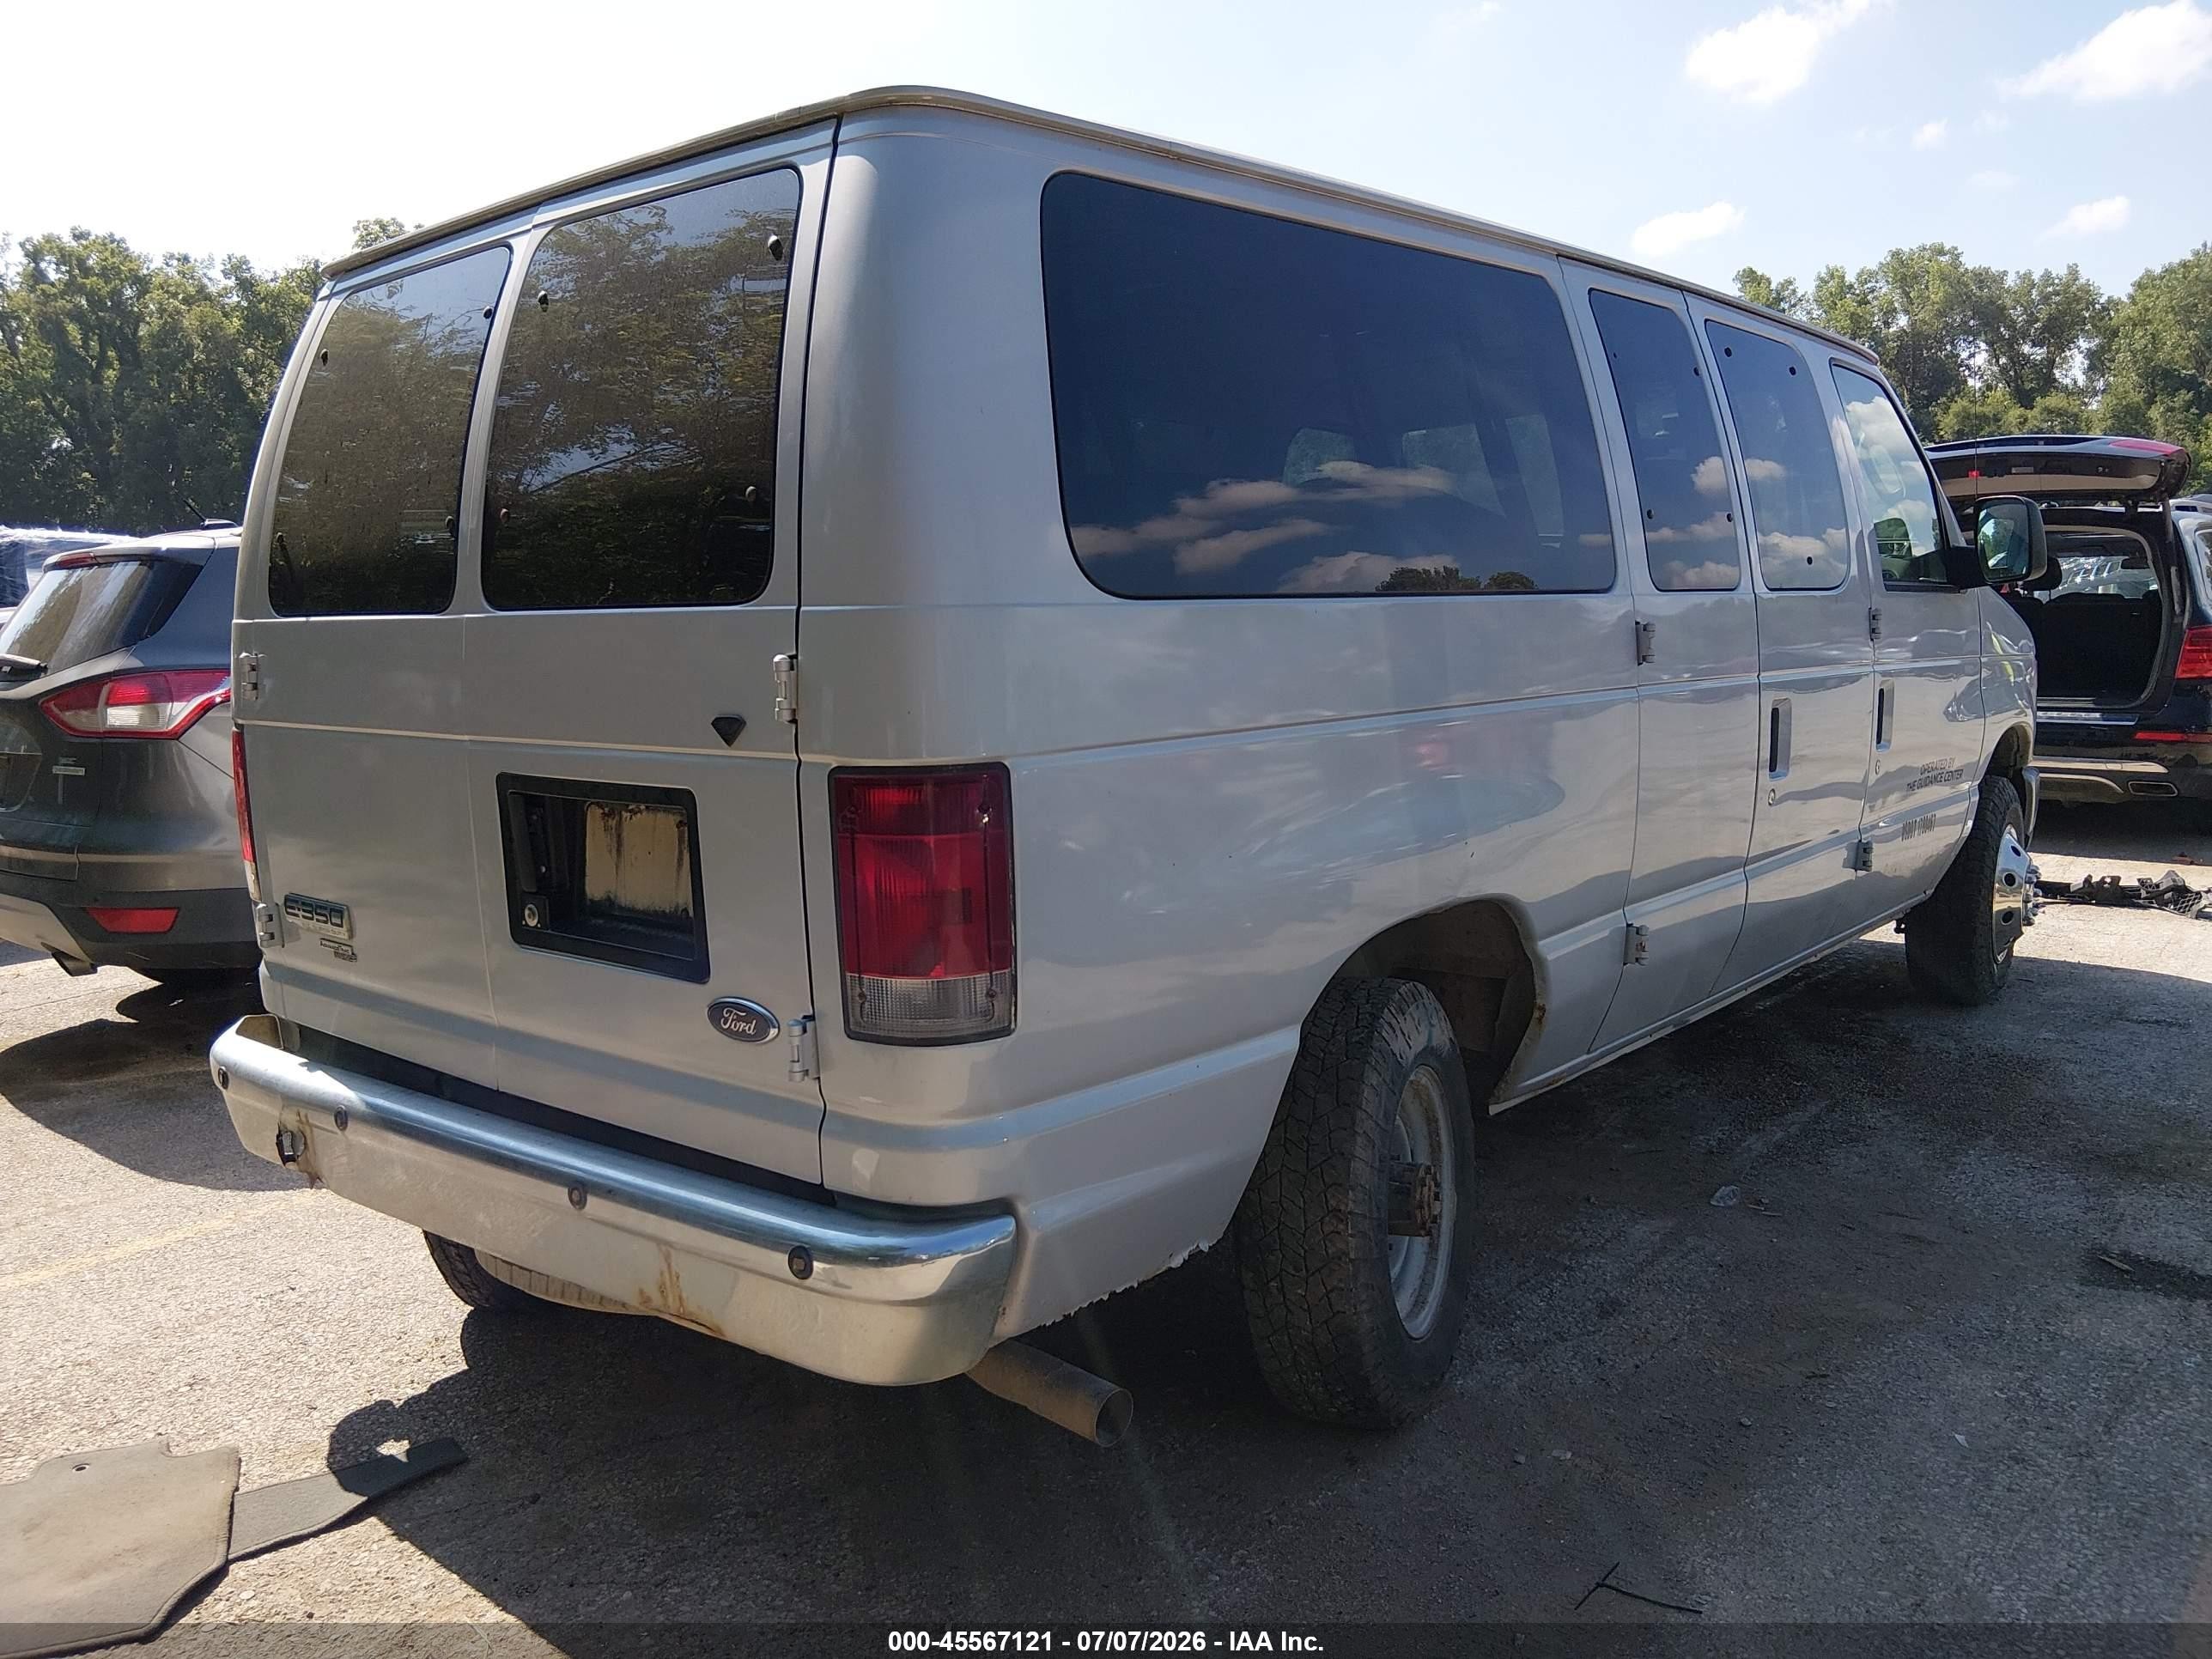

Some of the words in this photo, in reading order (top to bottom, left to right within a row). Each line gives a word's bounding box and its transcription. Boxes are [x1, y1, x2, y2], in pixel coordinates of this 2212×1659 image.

[1920, 758, 1948, 775] OPERATED
[1948, 757, 1956, 769] BY
[1907, 780, 1917, 791] THE
[1917, 771, 1944, 790] GUIDANCE
[1944, 769, 1964, 782] CENTER
[720, 1007, 757, 1036] Ford
